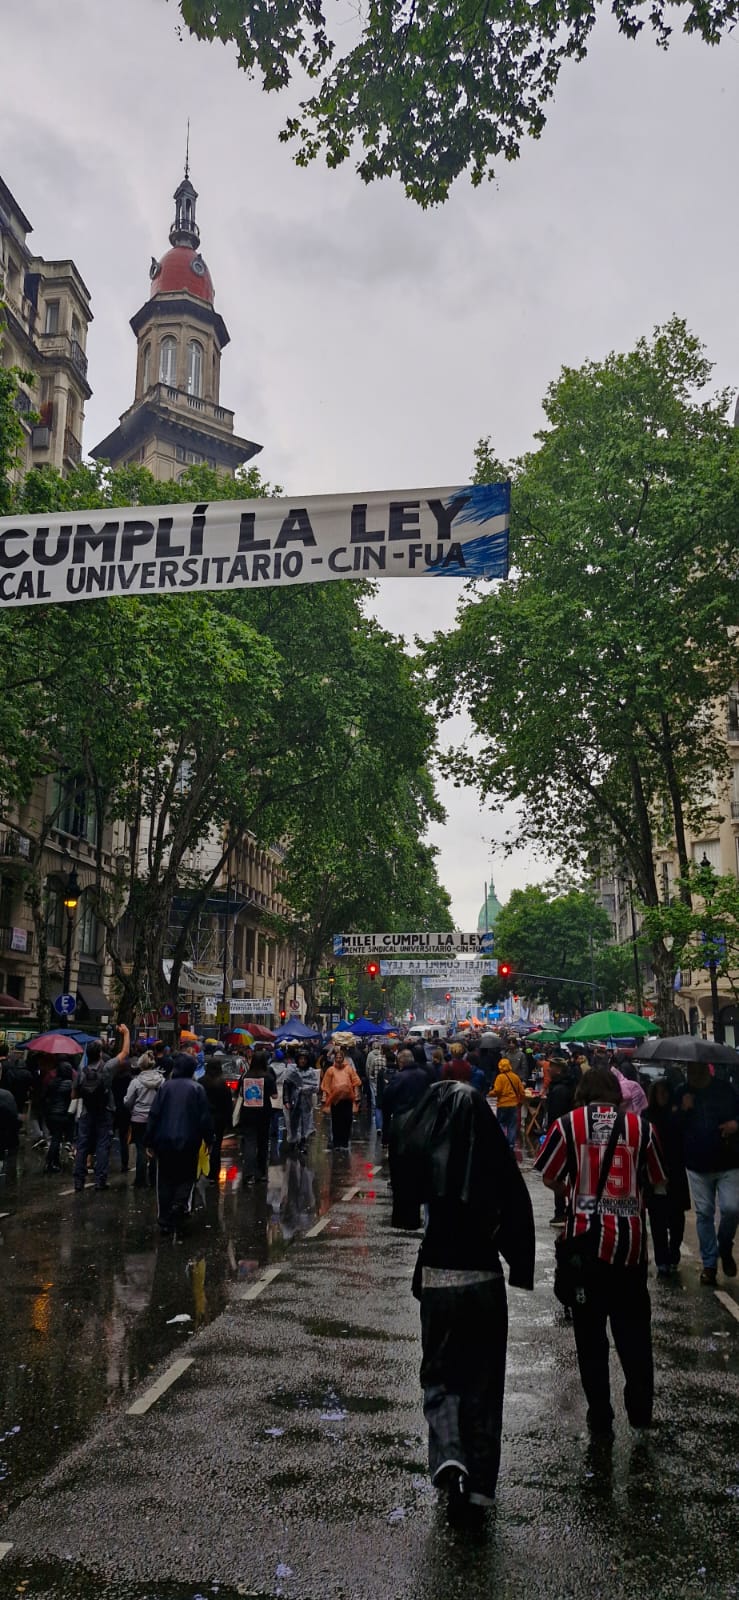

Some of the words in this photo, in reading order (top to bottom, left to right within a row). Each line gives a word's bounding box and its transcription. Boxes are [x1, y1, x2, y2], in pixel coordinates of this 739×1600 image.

[0, 504, 209, 568] CUMPLÍ
[237, 508, 317, 553] LA
[350, 496, 472, 544] LEY
[66, 551, 303, 594] UNIVERSITARIO
[342, 935, 376, 946] MILEI
[438, 934, 454, 945] LA
[460, 934, 486, 945] LEY
[400, 945, 451, 953] UNIVERSITARIO
[61, 995, 70, 1006] E
